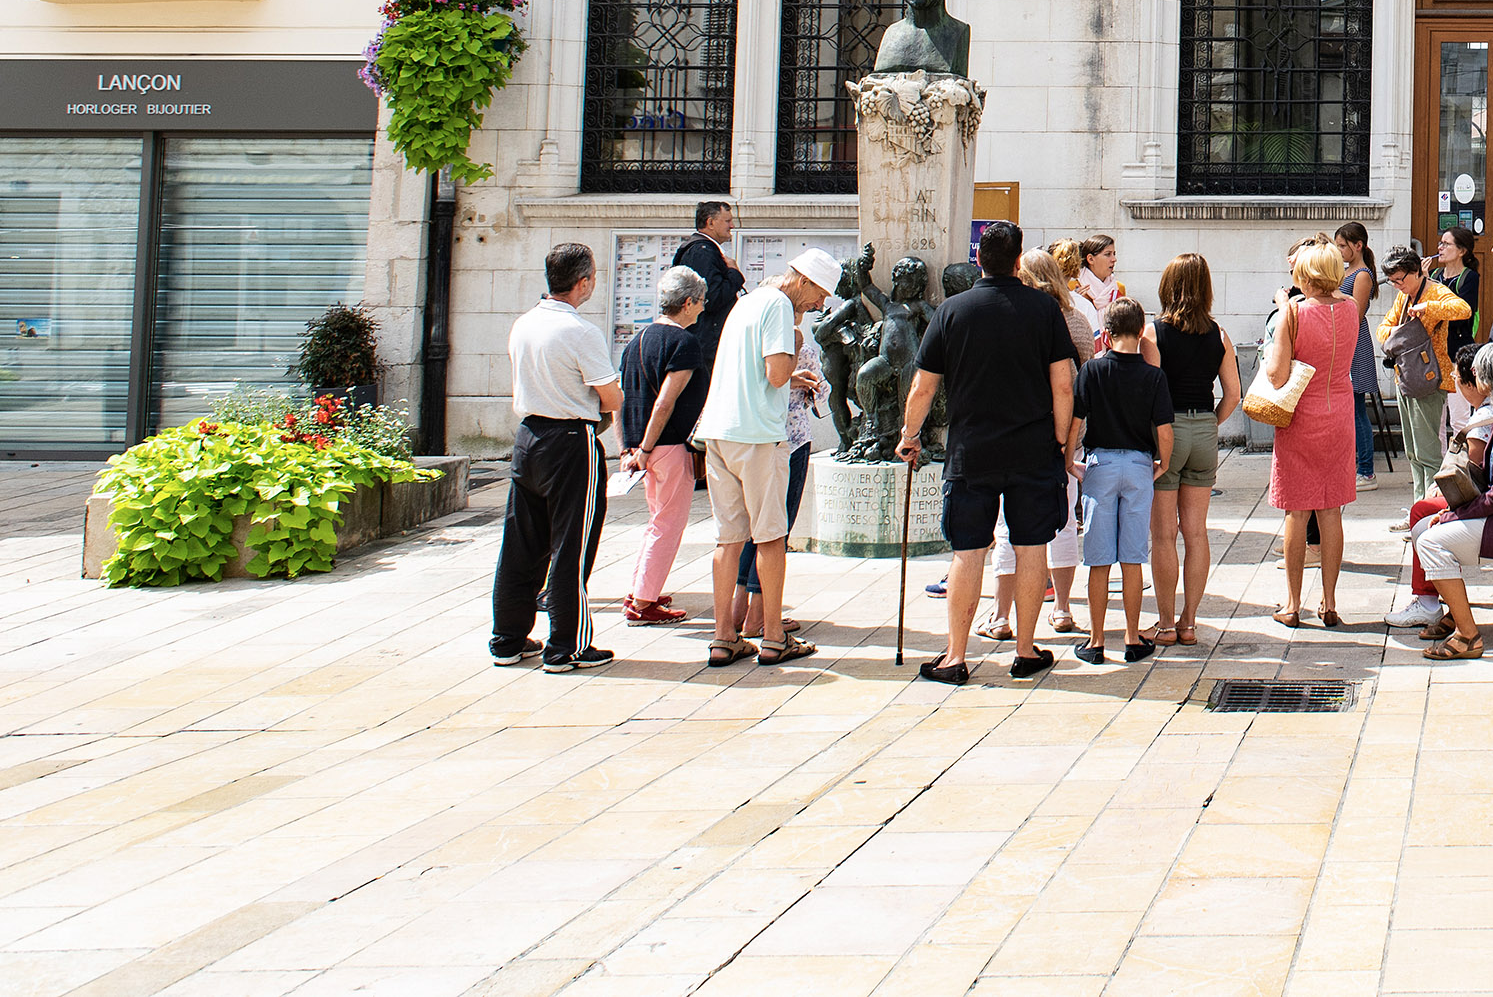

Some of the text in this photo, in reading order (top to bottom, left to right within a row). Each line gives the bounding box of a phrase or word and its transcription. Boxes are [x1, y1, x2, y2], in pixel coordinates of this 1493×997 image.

[97, 74, 182, 95] LANÇON
[66, 102, 212, 115] HORLOGER BIJOUTIER
[832, 472, 936, 484] CONVIER QUEQU'UN
